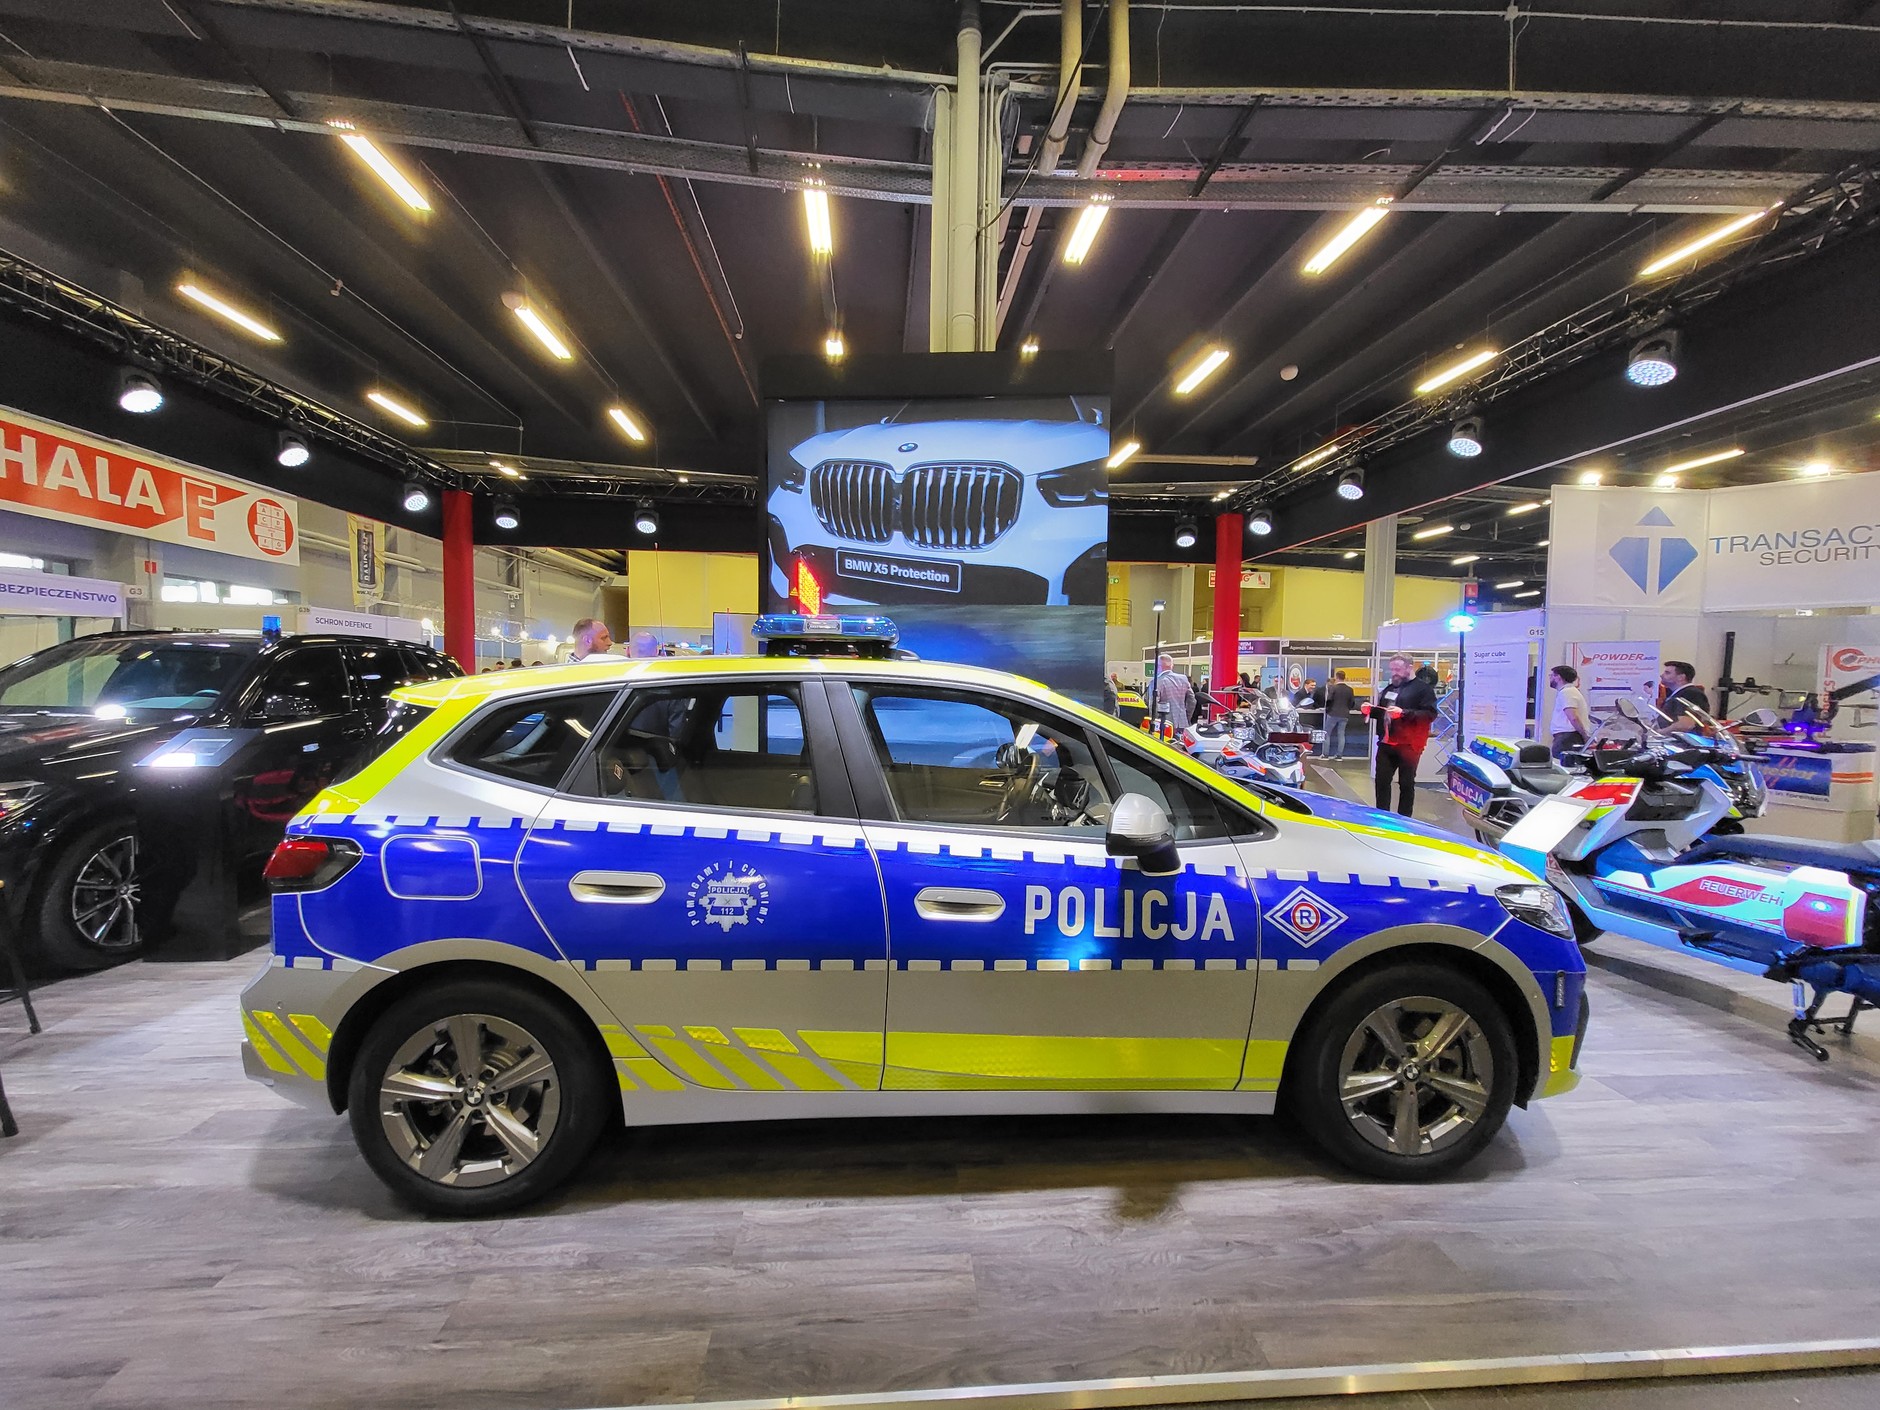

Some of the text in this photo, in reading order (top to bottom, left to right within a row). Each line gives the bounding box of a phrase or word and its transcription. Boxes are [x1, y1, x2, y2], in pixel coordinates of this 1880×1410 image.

[0, 427, 217, 542] HALA E
[1760, 545, 1880, 566] SECURIT
[845, 558, 950, 583] BMW X5 Protection
[0, 583, 117, 603] BEZPIECZEŃSTWO
[129, 588, 143, 596] G3
[315, 616, 373, 630] SCHRON DEFENCE
[1474, 651, 1490, 659] Sugar
[1452, 778, 1484, 805] POLICJA
[686, 862, 720, 926] POMAGAMY
[728, 860, 733, 869] I
[711, 886, 746, 894] POLICJA
[720, 907, 734, 915] 112
[1024, 884, 1235, 941] POLICJA
[1300, 909, 1312, 925] R
